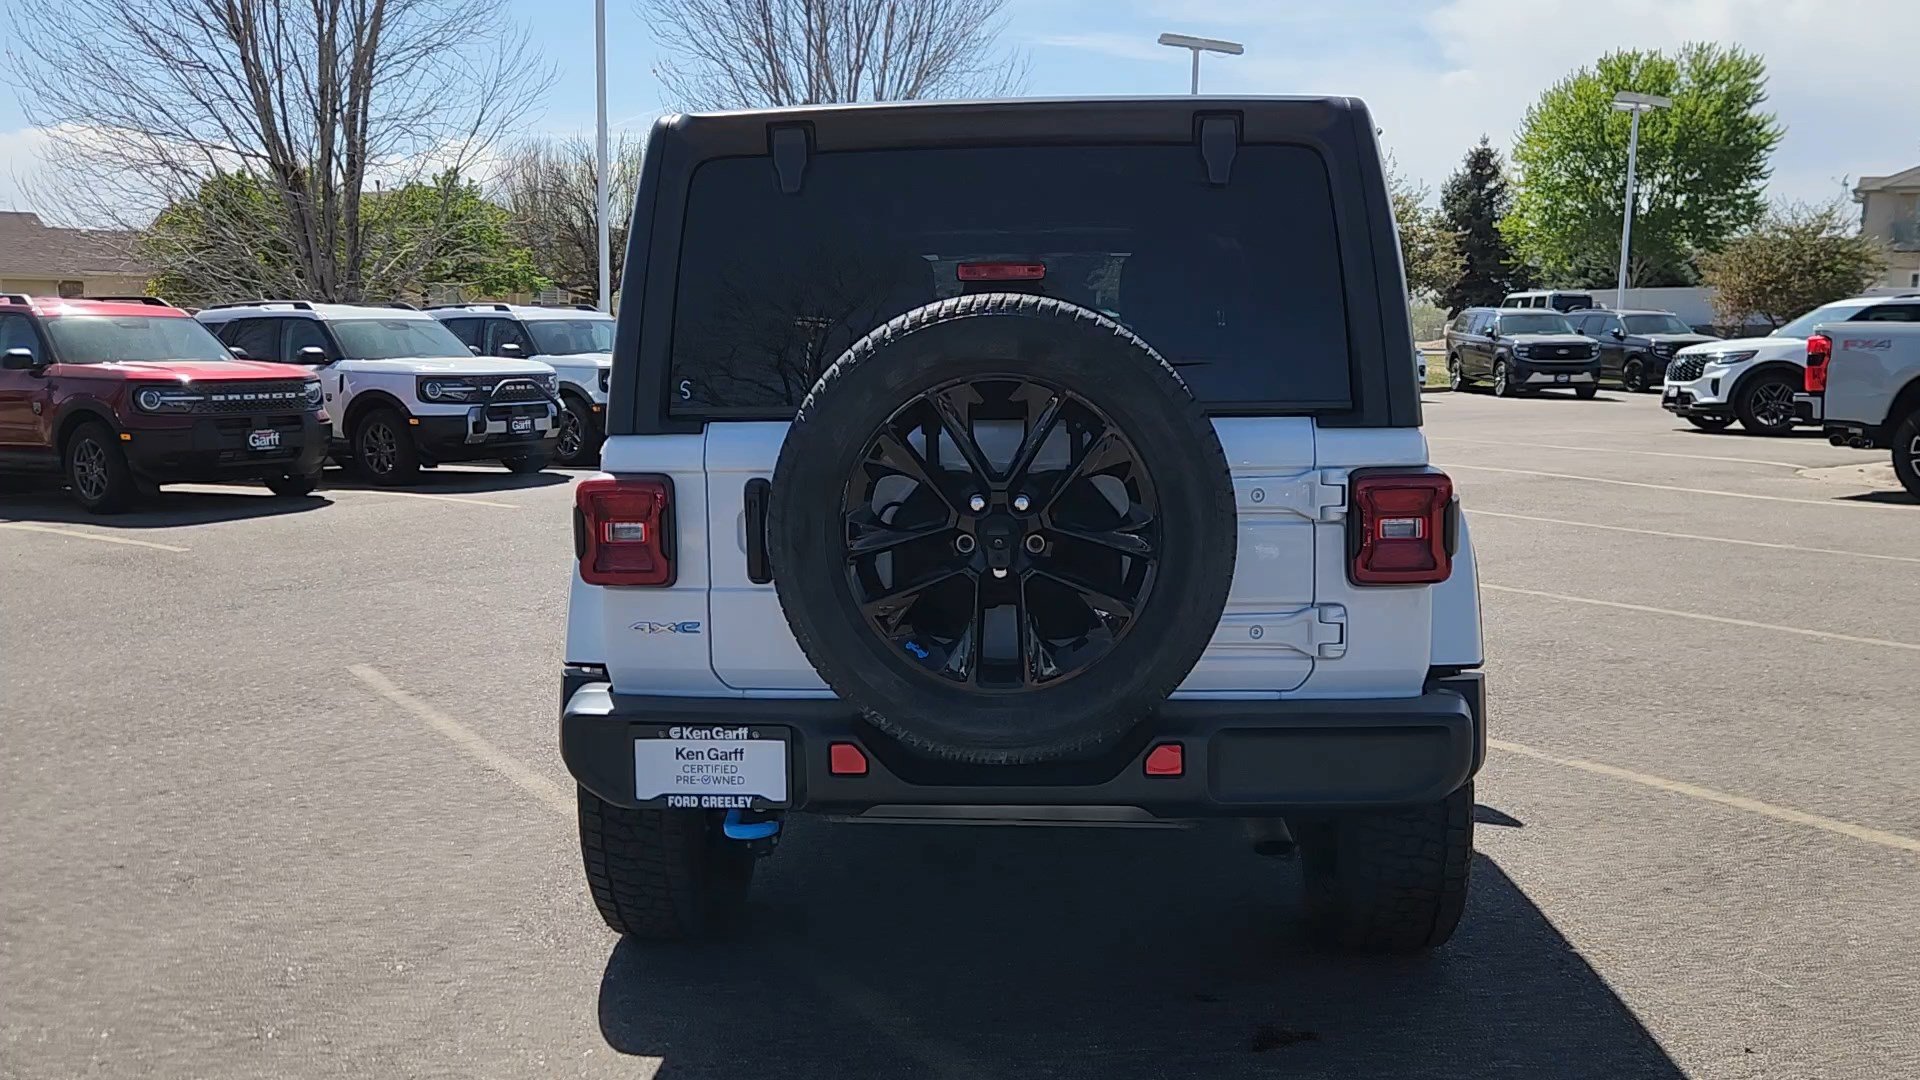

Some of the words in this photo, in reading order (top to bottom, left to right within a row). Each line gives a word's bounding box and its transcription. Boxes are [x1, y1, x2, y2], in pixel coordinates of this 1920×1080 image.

[1842, 339, 1892, 349] FX4
[680, 380, 691, 399] S
[211, 392, 296, 401] BRONCO
[512, 420, 531, 431] Garff
[248, 432, 280, 447] Garff
[682, 727, 711, 740] Ken
[712, 727, 749, 740] Garff
[675, 747, 705, 761] Ken
[708, 747, 745, 761] Garff
[682, 764, 738, 774] CERTIFIED
[667, 796, 699, 808] FORD
[701, 796, 753, 808] GREELEY
